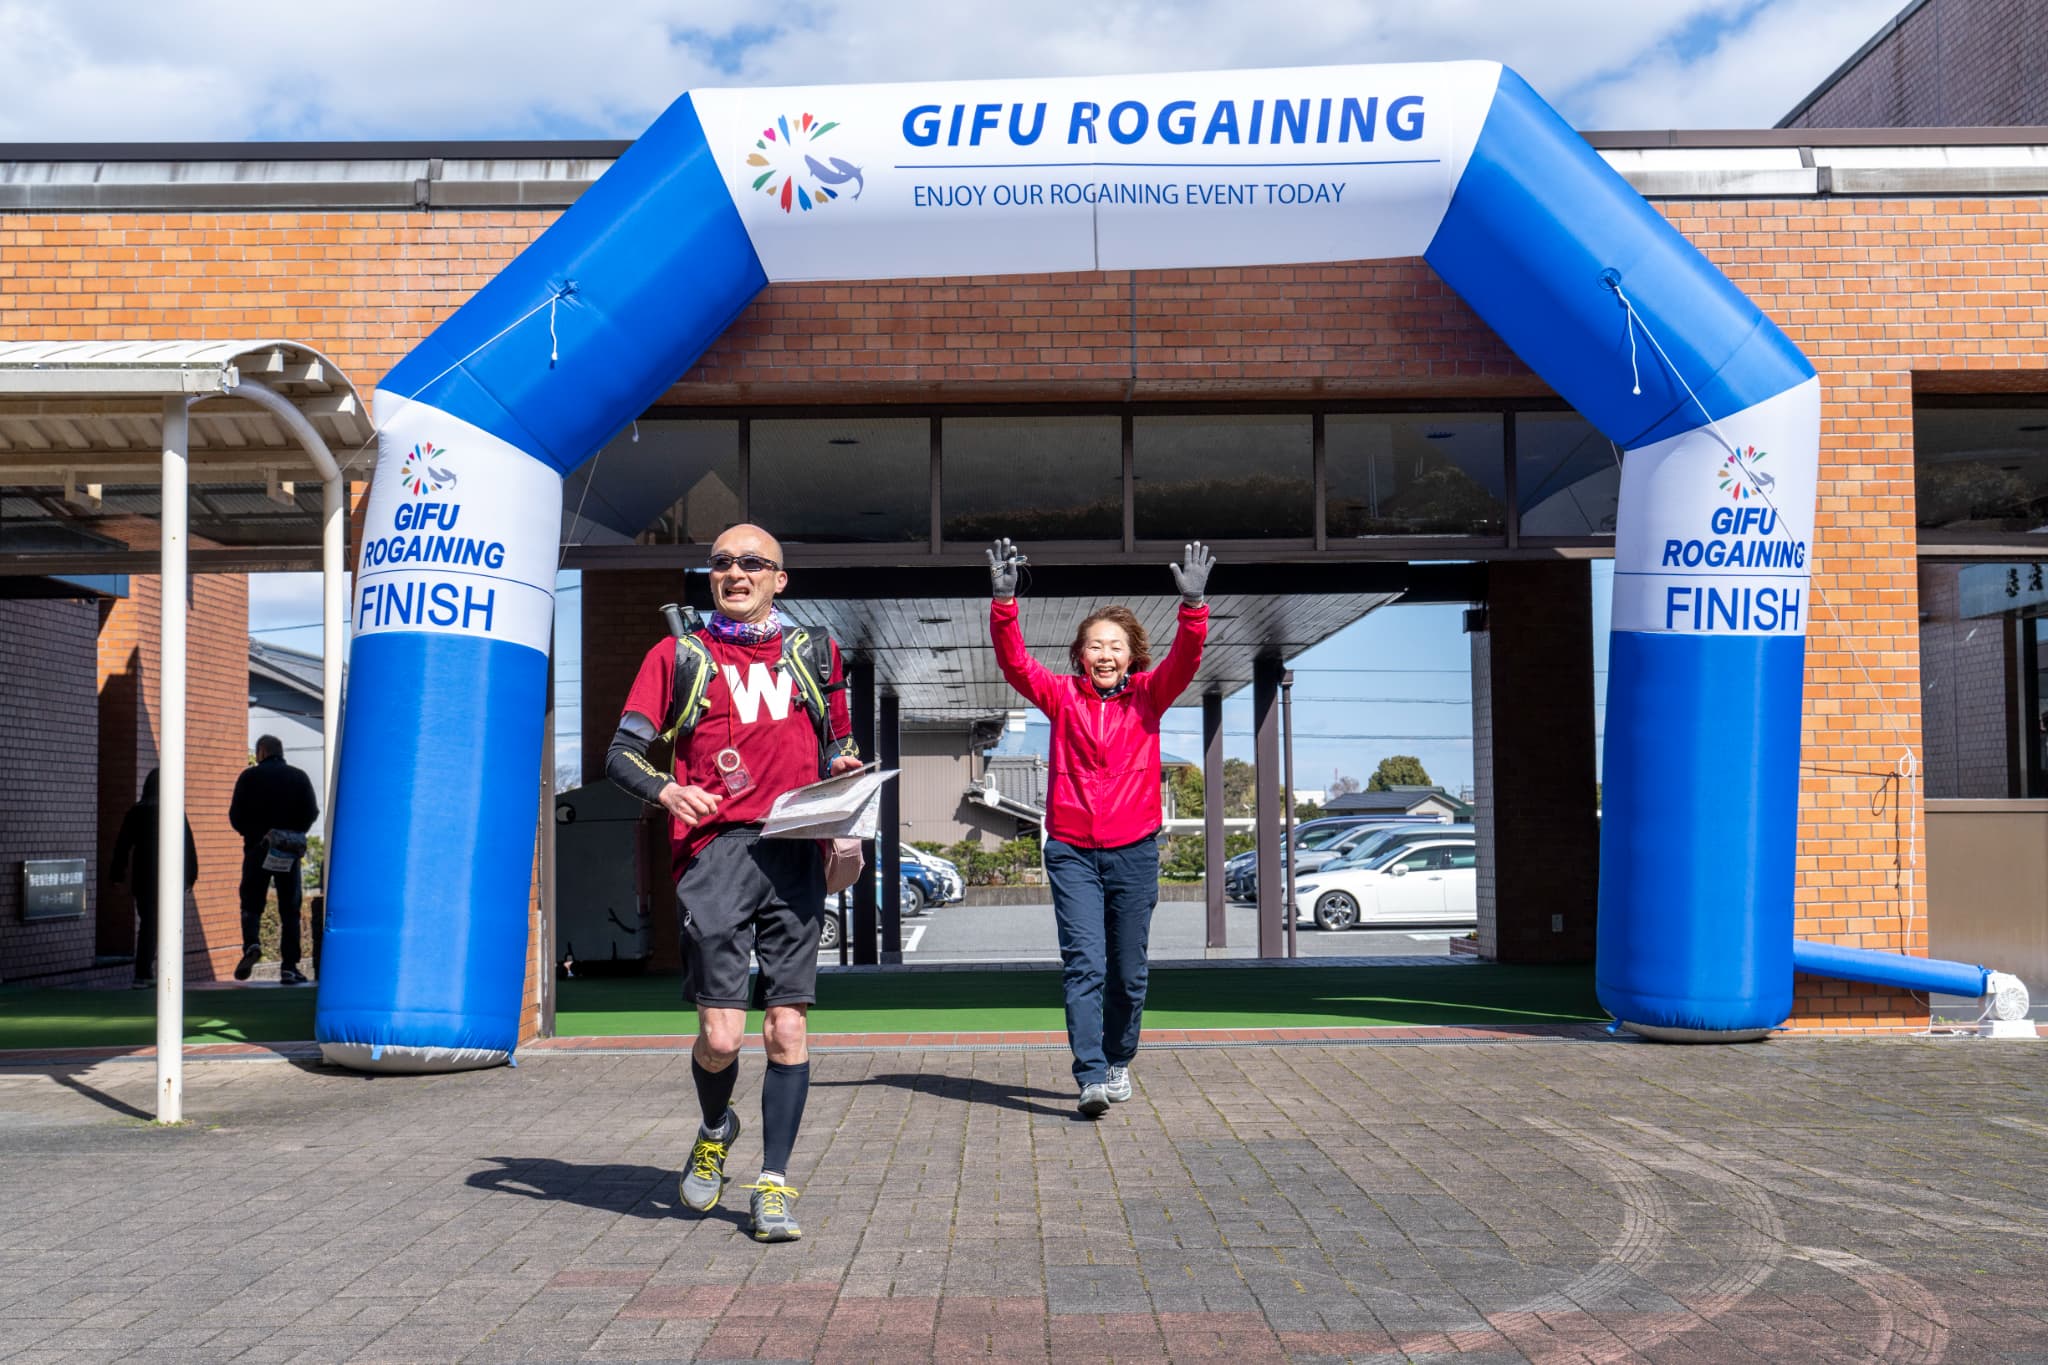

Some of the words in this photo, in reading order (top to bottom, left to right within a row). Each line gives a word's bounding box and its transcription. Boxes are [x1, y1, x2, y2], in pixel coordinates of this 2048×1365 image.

[902, 103, 1047, 147] GIFU
[1068, 96, 1424, 146] ROGAINING
[913, 184, 986, 208] ENJOY
[992, 184, 1043, 207] OUR
[1050, 183, 1179, 206] ROGAINING
[1186, 183, 1259, 207] EVENT
[1263, 182, 1344, 206] TODAY
[394, 502, 460, 532] GIFU
[1711, 506, 1777, 535] GIFU
[364, 535, 505, 568] ROGAINING
[1663, 539, 1805, 569] ROGAINING
[358, 582, 495, 632] FINISH
[1666, 587, 1800, 631] FINISH
[721, 662, 793, 724] W
